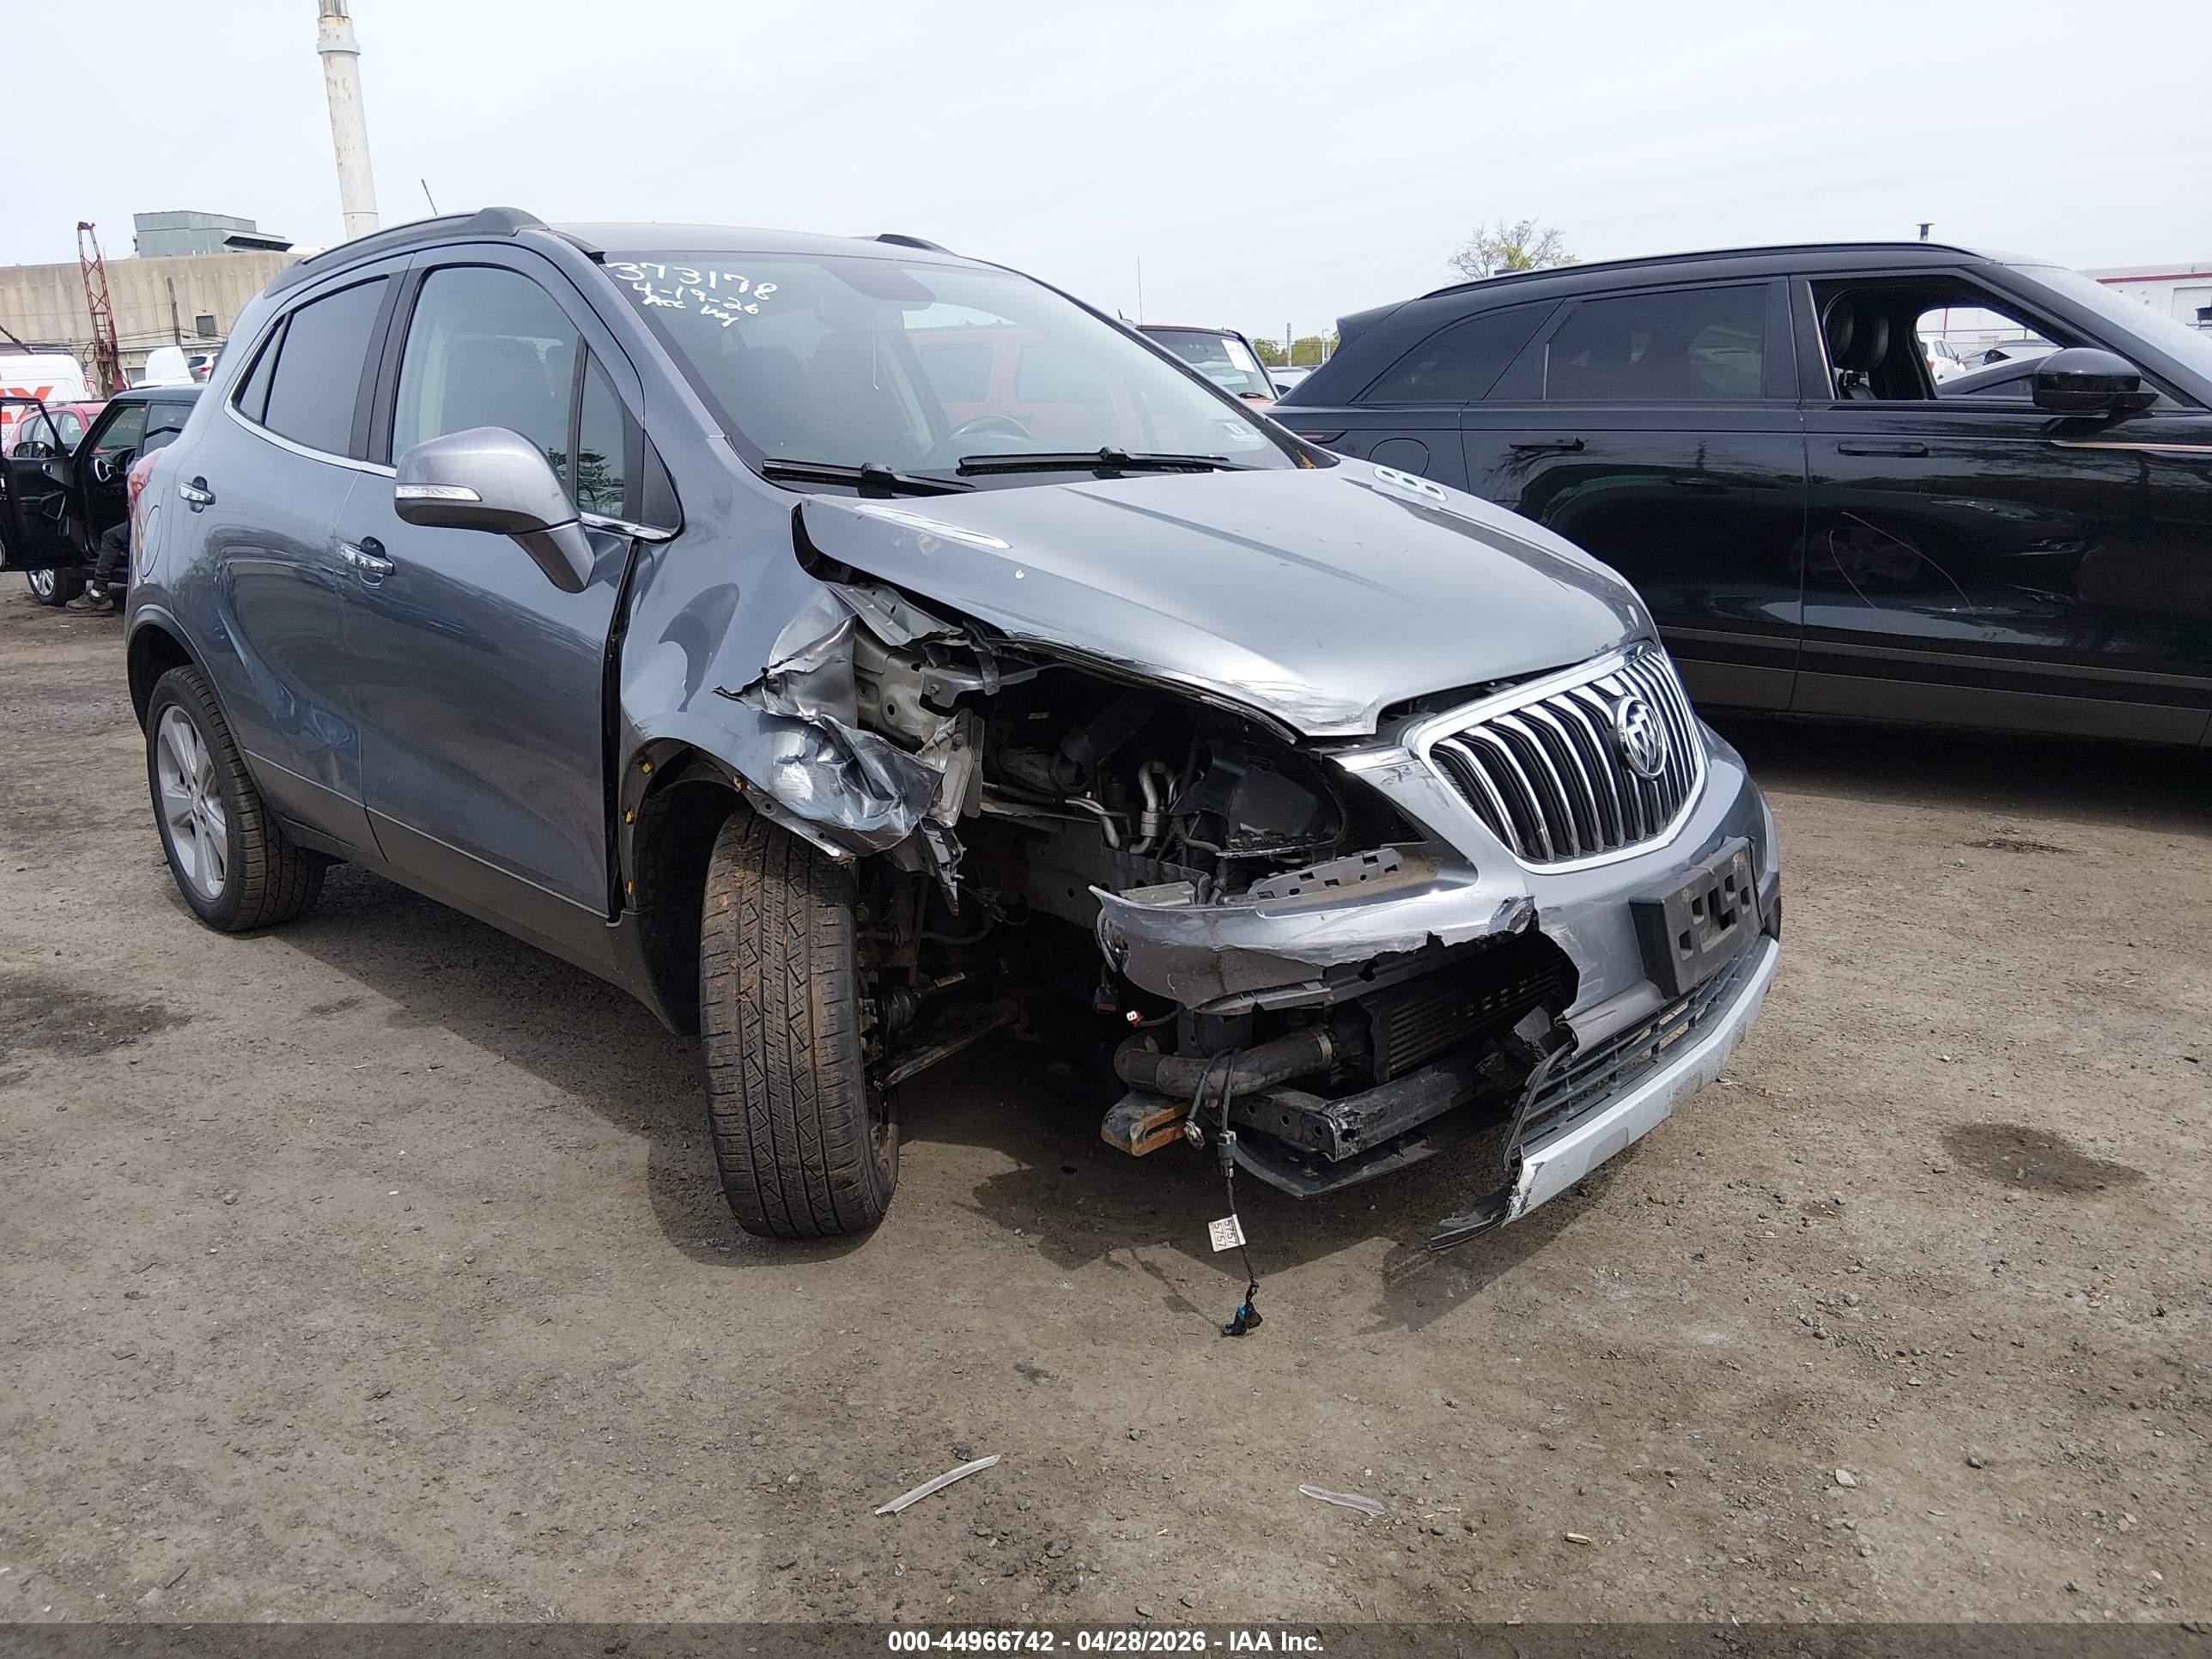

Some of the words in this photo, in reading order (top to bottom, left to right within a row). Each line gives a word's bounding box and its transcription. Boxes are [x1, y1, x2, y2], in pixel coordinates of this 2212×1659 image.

[605, 262, 778, 301] 373178
[1213, 1222, 1227, 1248] 5757
[1224, 1219, 1237, 1244] 5757
